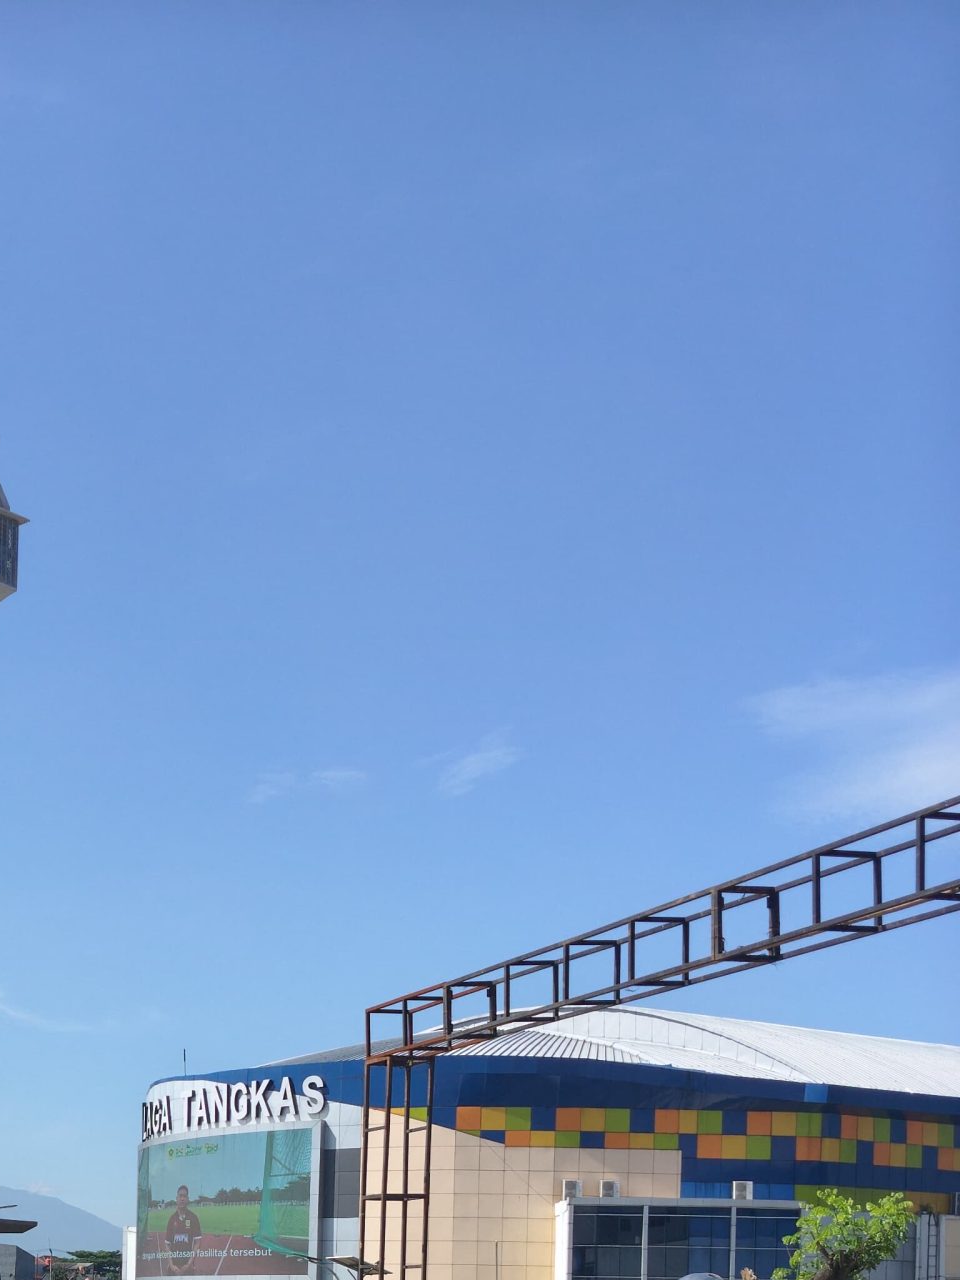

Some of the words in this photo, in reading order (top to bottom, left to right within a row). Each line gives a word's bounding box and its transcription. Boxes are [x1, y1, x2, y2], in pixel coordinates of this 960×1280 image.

[142, 1095, 173, 1142] LAGA
[181, 1075, 326, 1129] TANGKAS
[230, 1248, 272, 1257] tersebut
